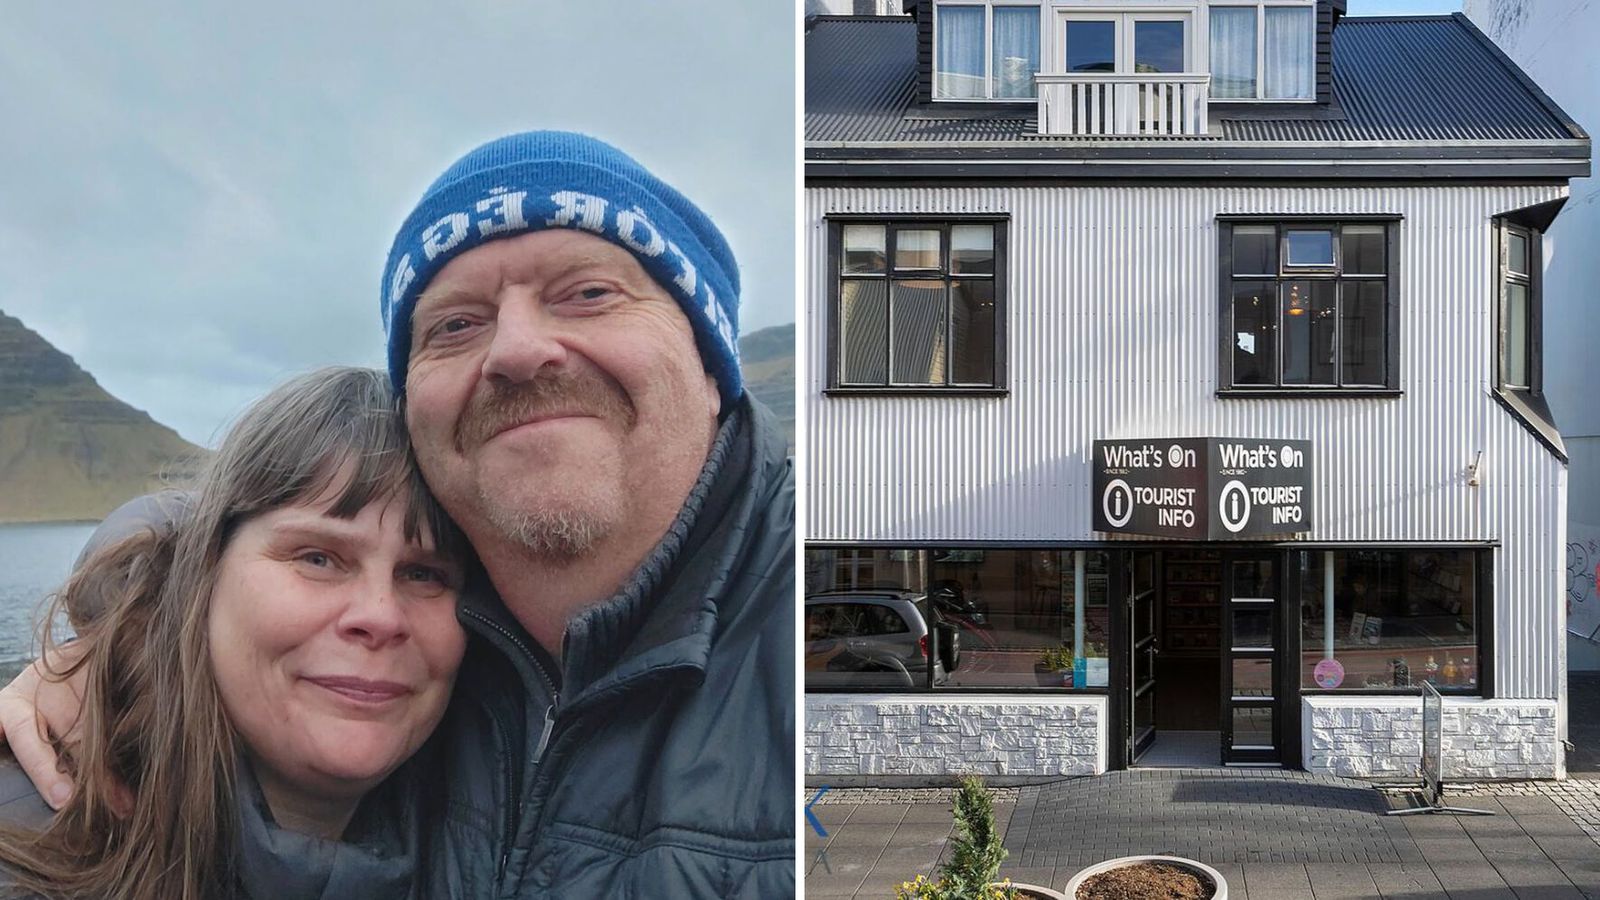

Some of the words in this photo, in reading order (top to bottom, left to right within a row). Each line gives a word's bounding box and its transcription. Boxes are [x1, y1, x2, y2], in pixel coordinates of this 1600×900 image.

[1103, 446, 1162, 468] What's
[1168, 444, 1196, 468] On
[1218, 444, 1277, 468] What's
[1280, 445, 1303, 468] On
[1134, 487, 1195, 507] TOURIST
[1251, 486, 1303, 505] TOURIST
[1158, 508, 1195, 528] INFO
[1272, 505, 1302, 524] INFO
